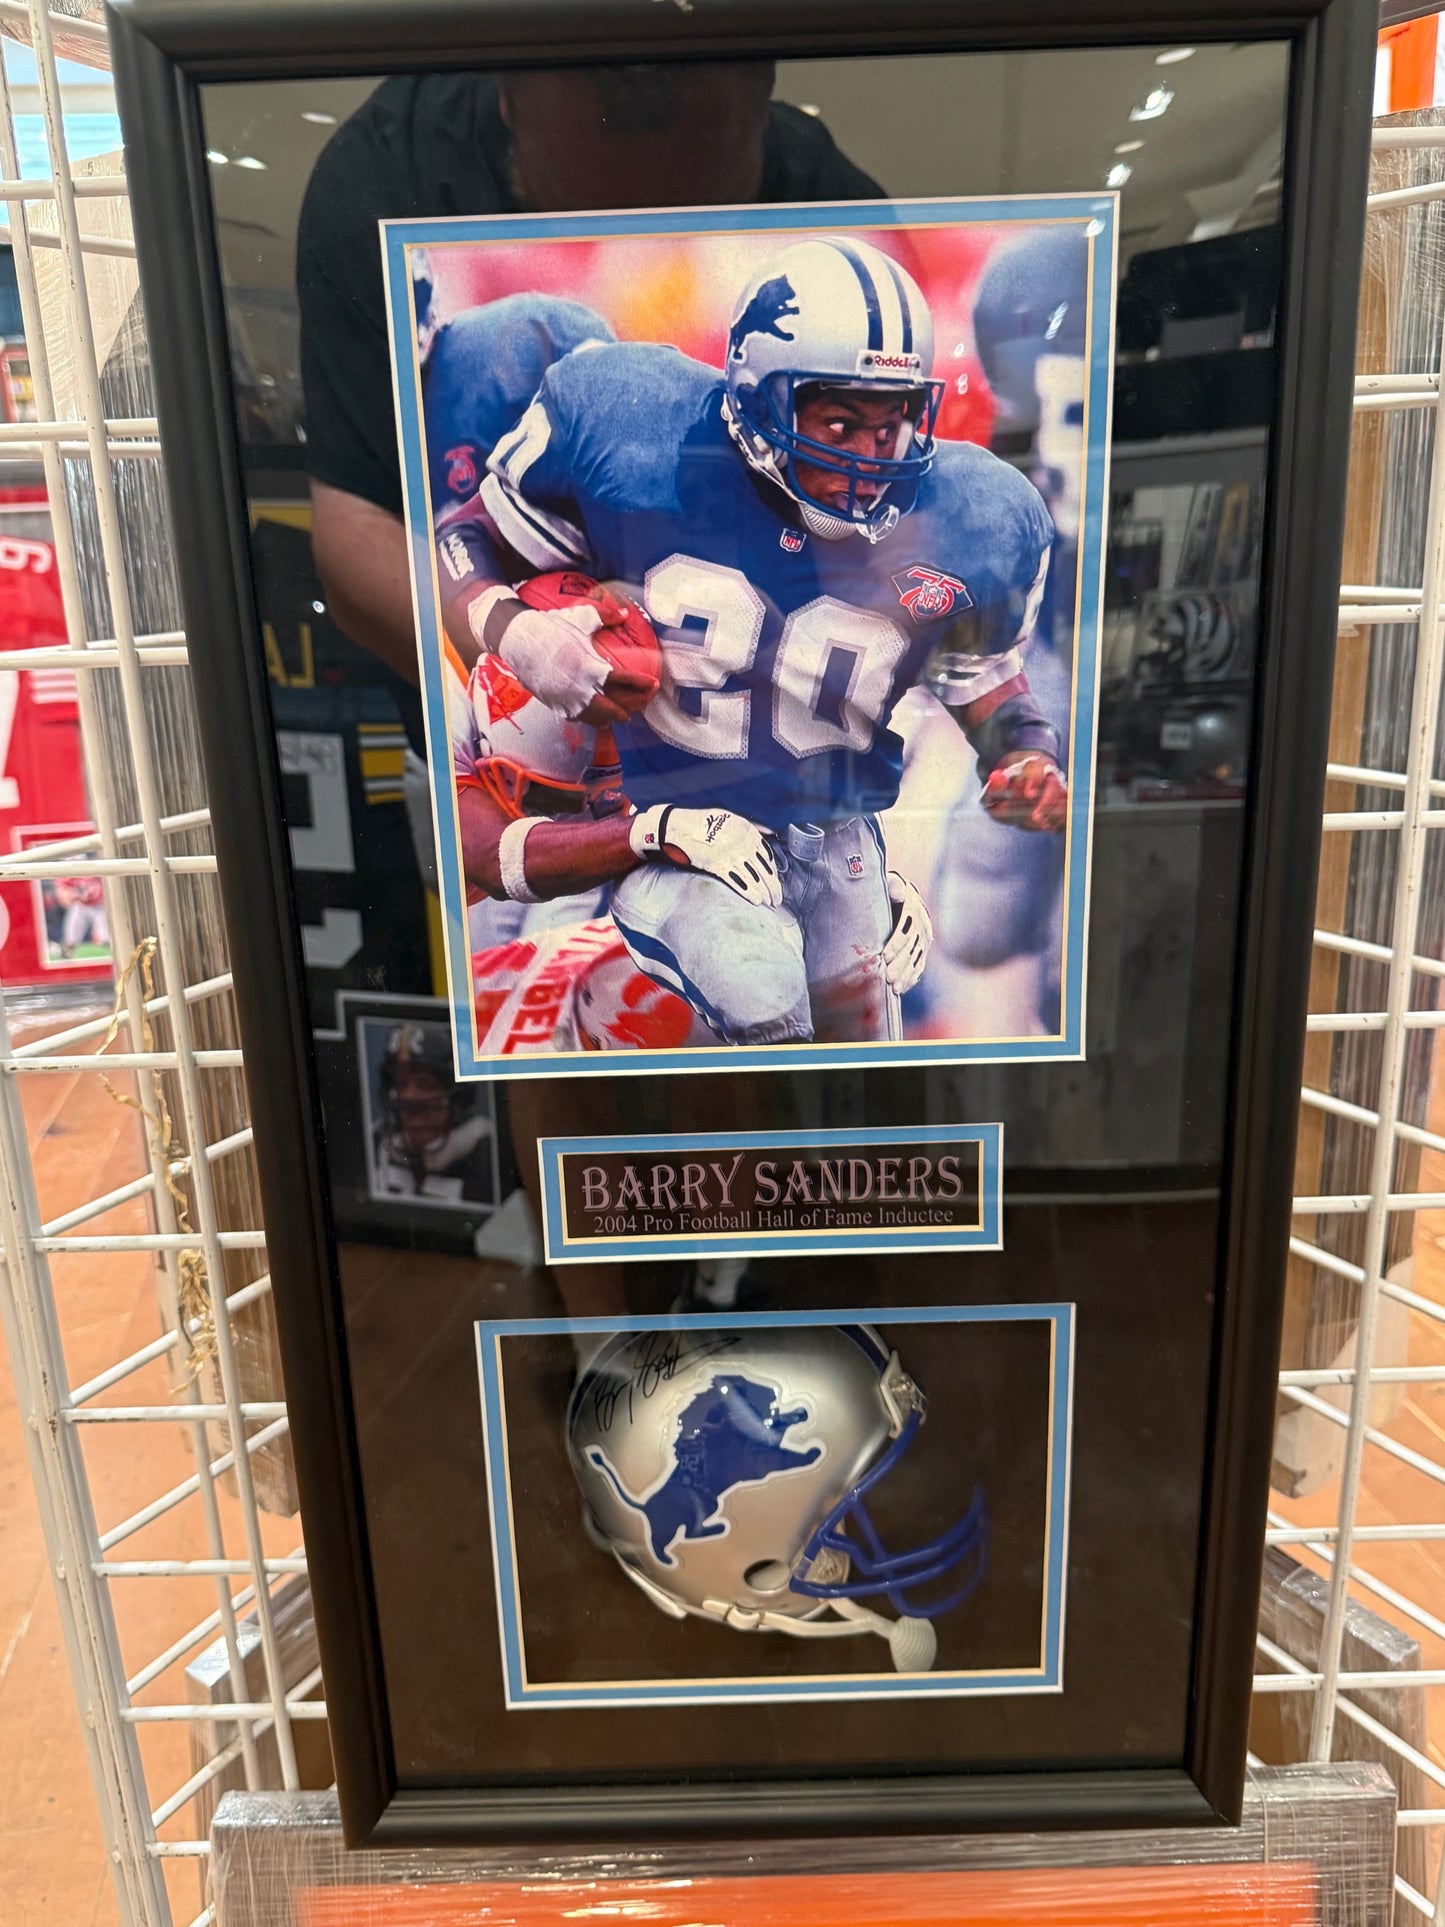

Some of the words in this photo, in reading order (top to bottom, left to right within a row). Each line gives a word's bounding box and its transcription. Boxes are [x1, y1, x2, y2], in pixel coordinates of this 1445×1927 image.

[874, 355, 909, 368] Riddell
[643, 552, 912, 760] 20
[581, 1152, 746, 1213] BARRY
[754, 1155, 963, 1206] SANDERS
[593, 1215, 637, 1234] 2004
[644, 1213, 674, 1232] Pro
[680, 1210, 751, 1231] Football
[757, 1209, 794, 1228] Hall
[800, 1208, 821, 1226] of
[824, 1208, 873, 1226] Fame
[879, 1206, 954, 1225] Inductee
